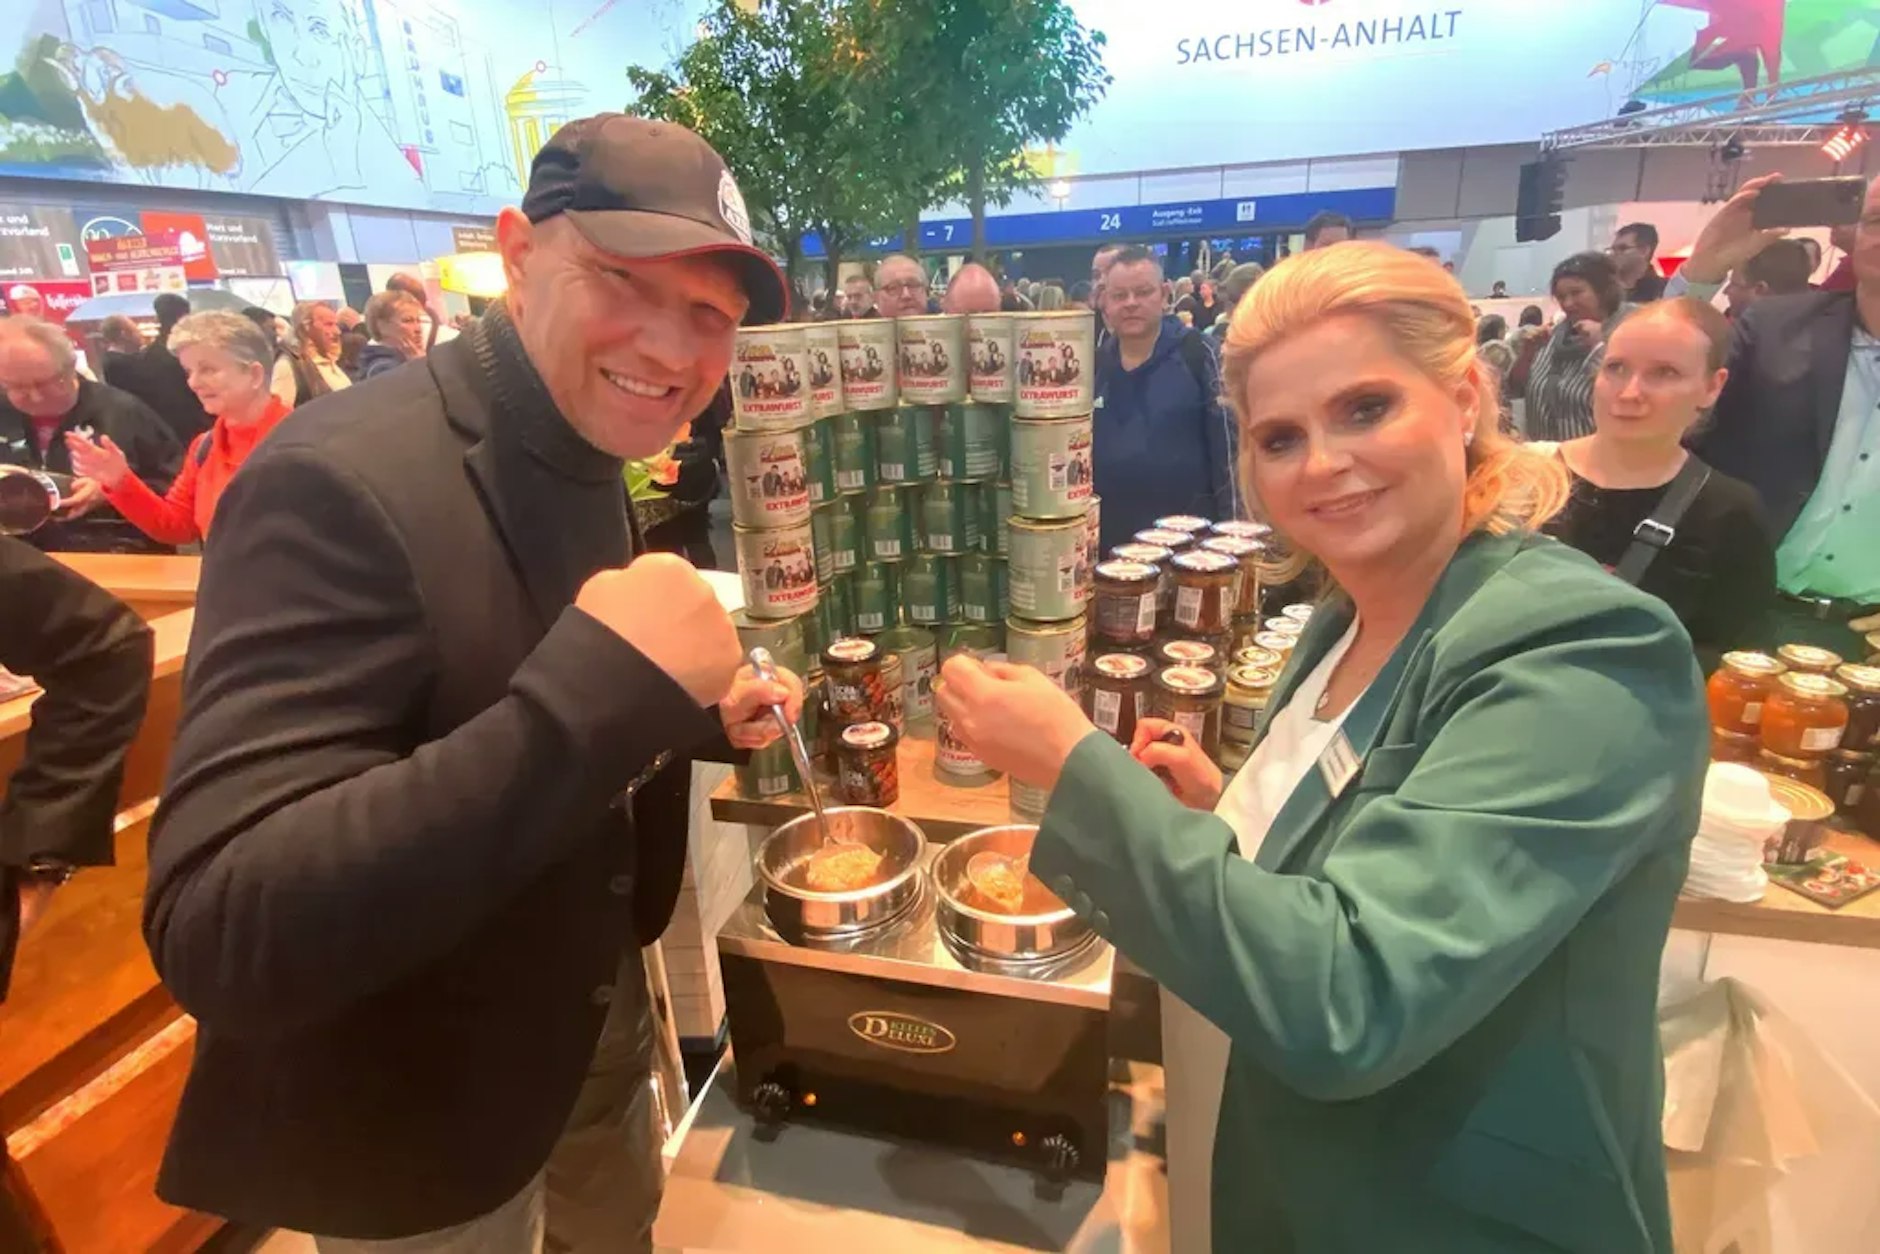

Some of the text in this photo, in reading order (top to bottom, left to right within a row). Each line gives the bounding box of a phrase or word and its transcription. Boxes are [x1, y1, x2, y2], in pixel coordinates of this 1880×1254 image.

[1177, 11, 1462, 64] SACHSEN-ANHALT
[1101, 213, 1121, 231] 24
[944, 225, 954, 241] 7
[1020, 389, 1080, 400] EXTRAWURST
[743, 401, 801, 413] EXTRAWURST
